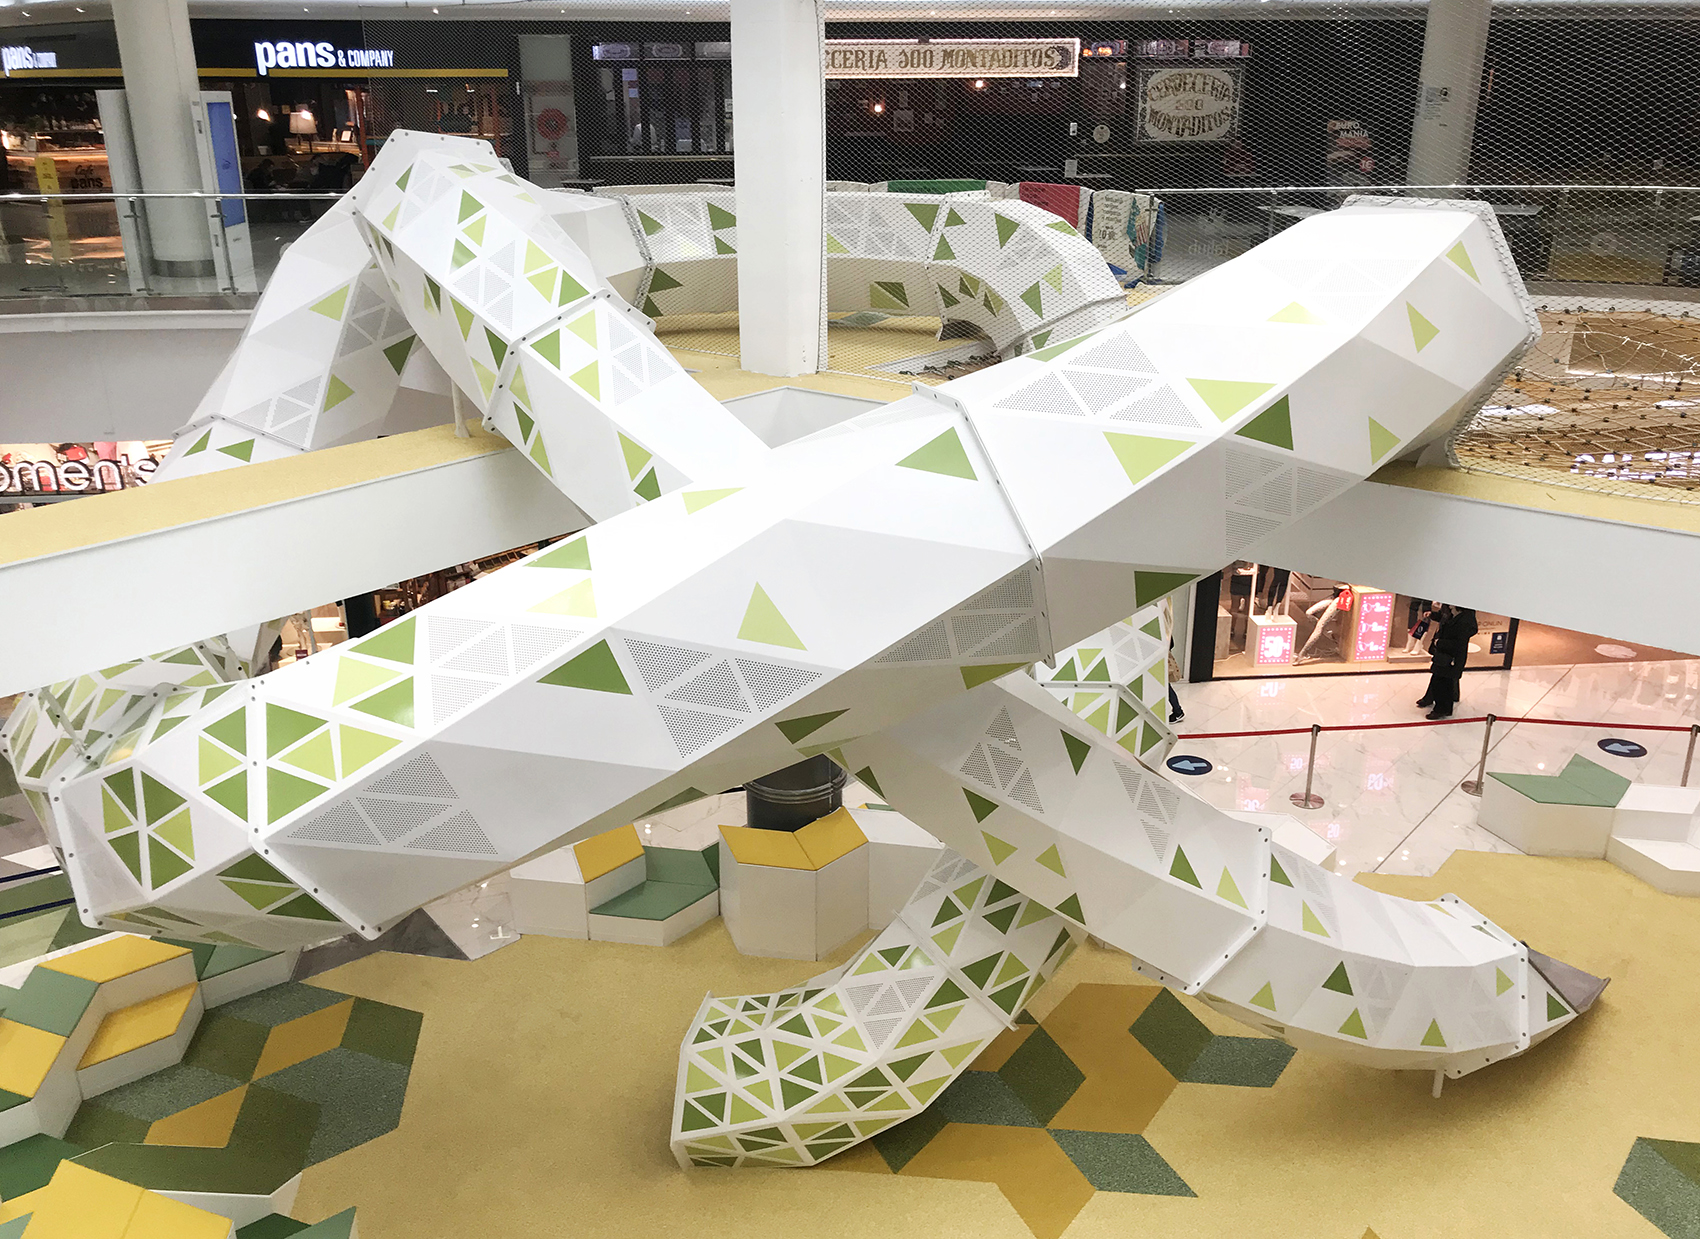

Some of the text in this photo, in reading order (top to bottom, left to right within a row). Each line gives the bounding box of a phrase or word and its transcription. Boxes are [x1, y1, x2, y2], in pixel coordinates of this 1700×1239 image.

[254, 41, 394, 76] pans & COMPANY
[937, 48, 1056, 71] MONTADITOS
